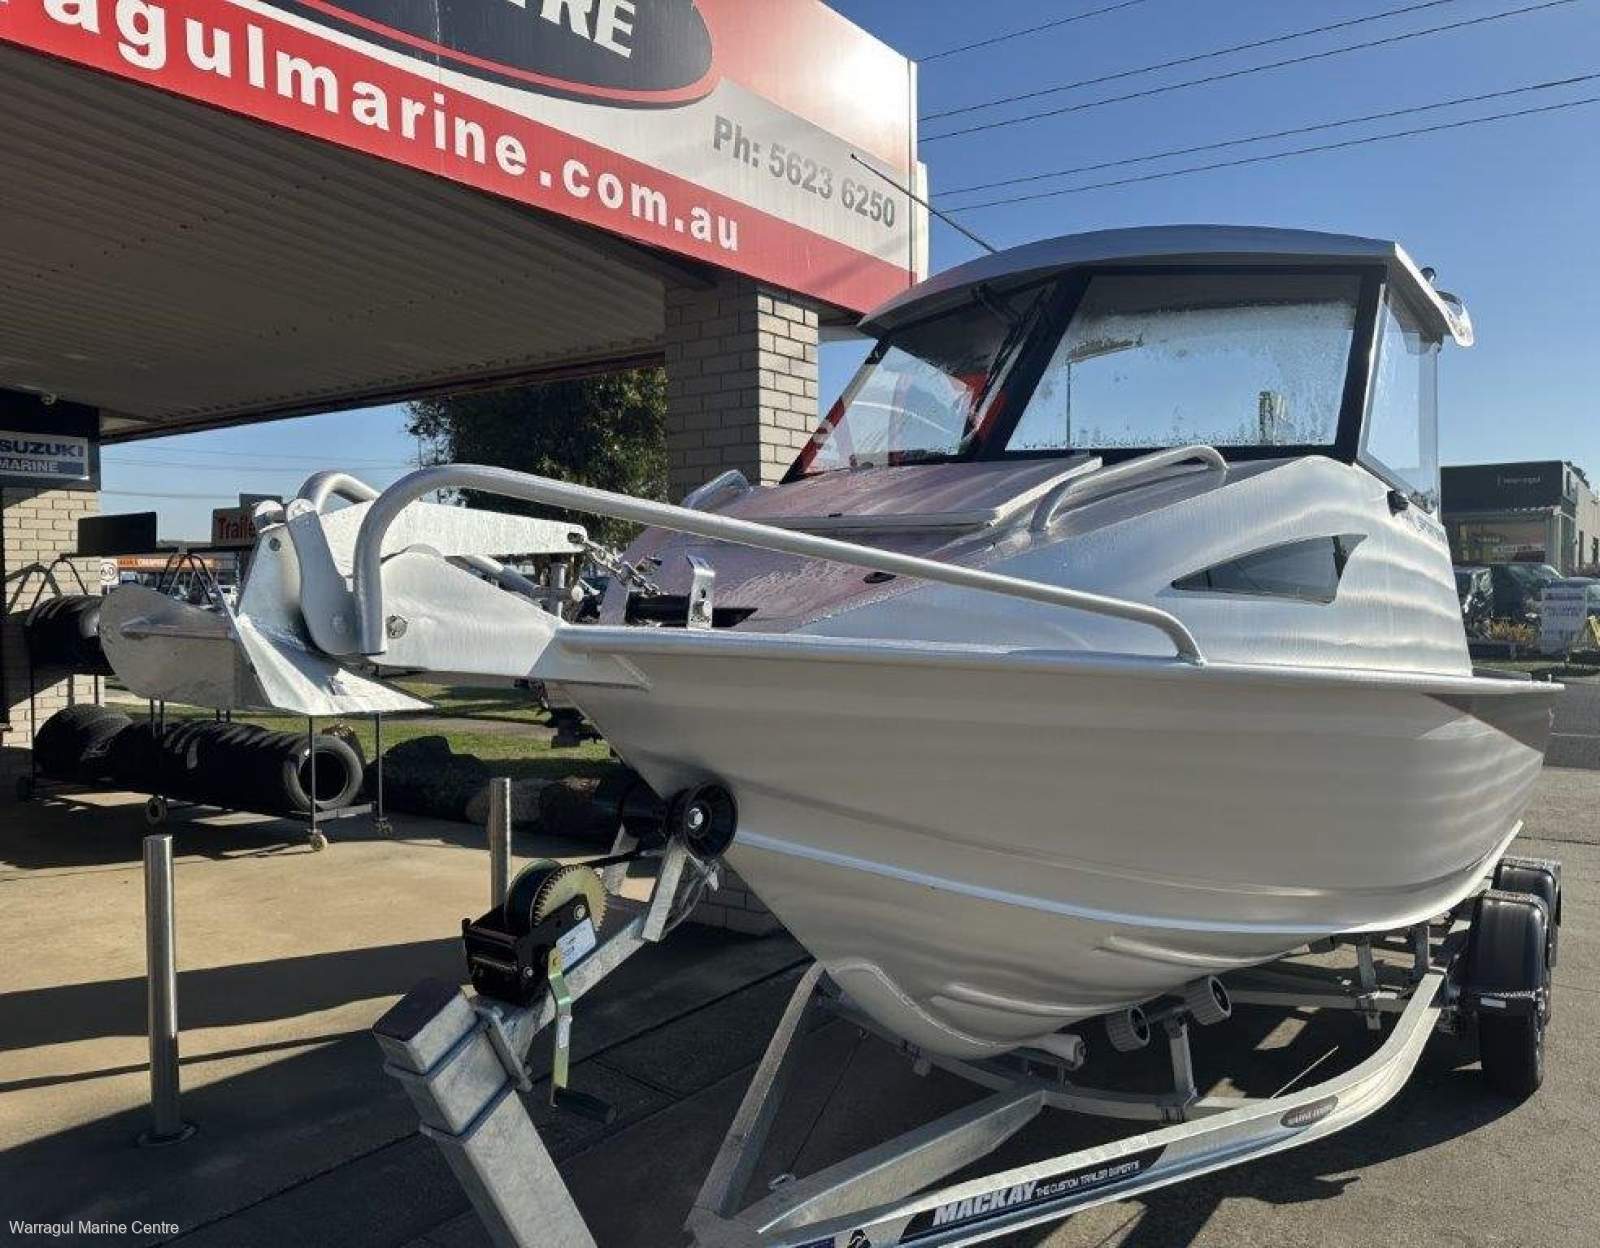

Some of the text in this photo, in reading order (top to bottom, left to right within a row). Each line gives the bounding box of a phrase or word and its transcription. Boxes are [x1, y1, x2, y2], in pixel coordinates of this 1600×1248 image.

[713, 114, 895, 228] Ph: 5623 6250
[0, 439, 84, 457] SUZUKI
[932, 1179, 1039, 1226] MACKAY
[1050, 1177, 1079, 1195] CUSTOM
[1080, 1168, 1108, 1186] TRAILER
